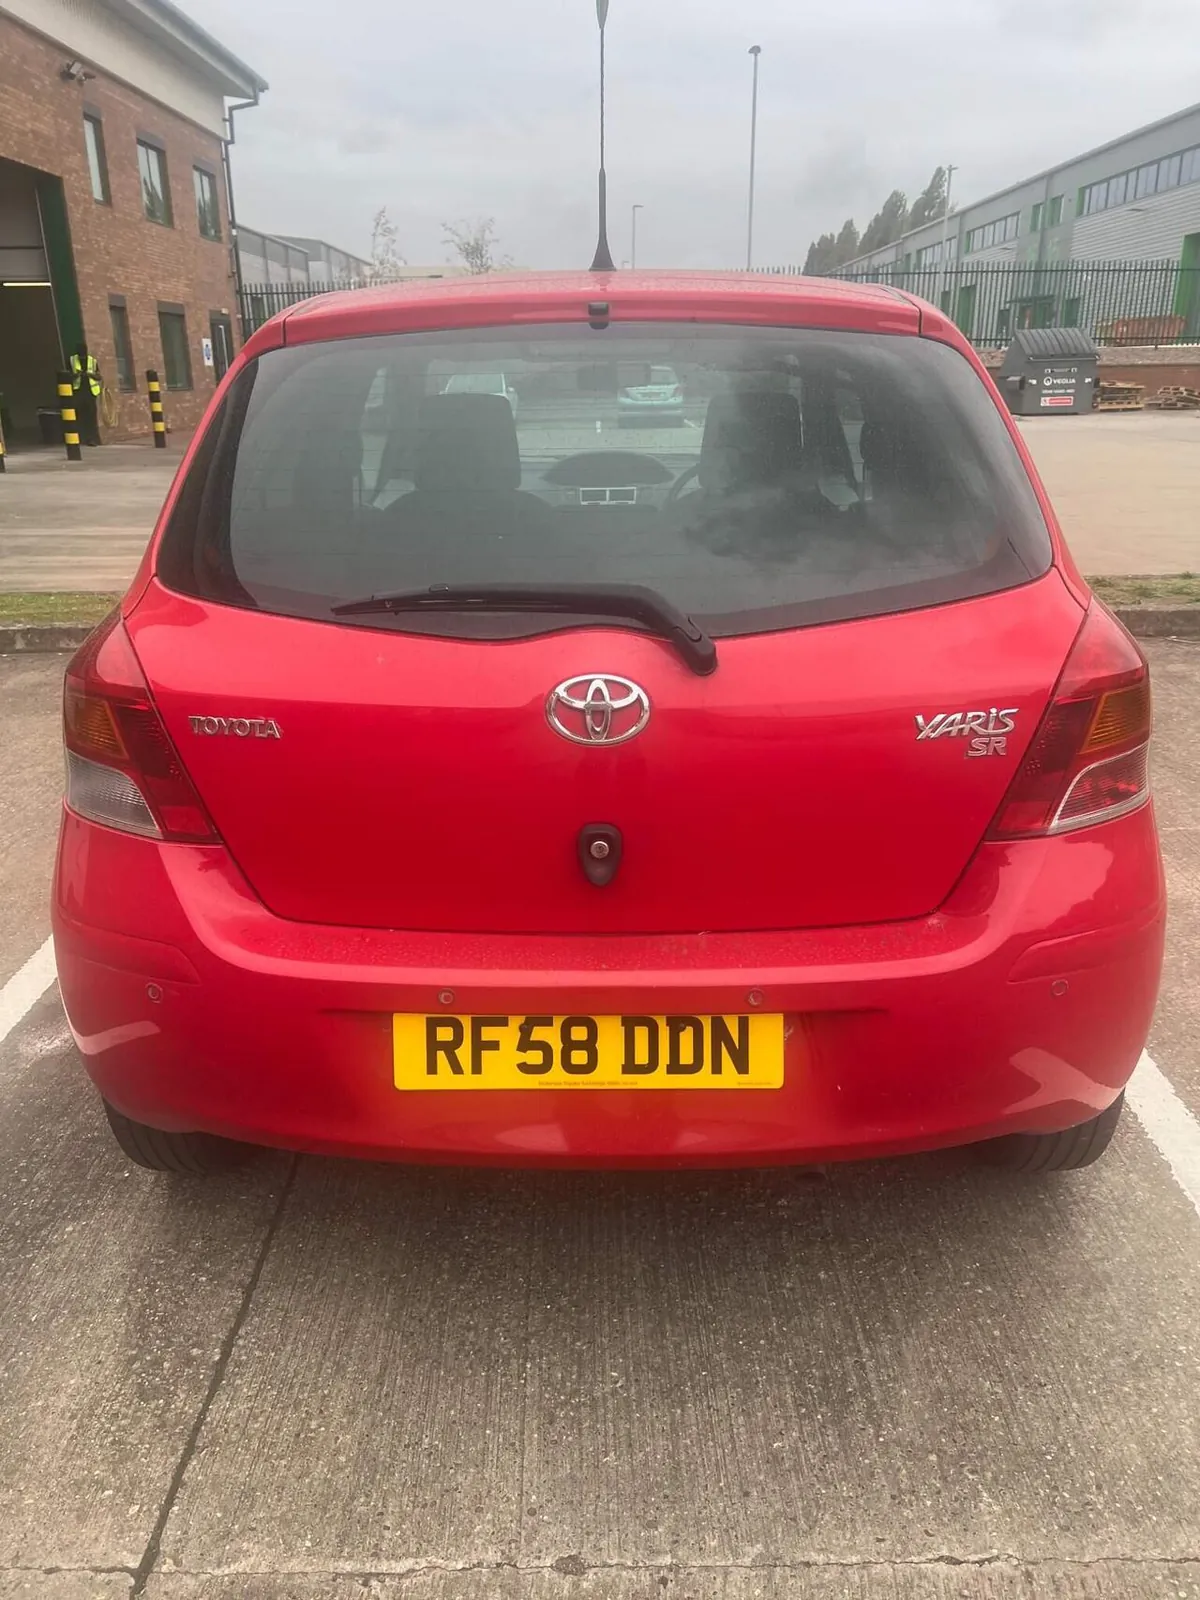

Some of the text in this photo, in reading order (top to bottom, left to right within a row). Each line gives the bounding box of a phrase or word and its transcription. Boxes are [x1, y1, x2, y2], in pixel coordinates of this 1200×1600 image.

[188, 715, 281, 739] TOYOTA
[967, 737, 1007, 757] SR
[425, 1015, 749, 1075] RF58 DDN
